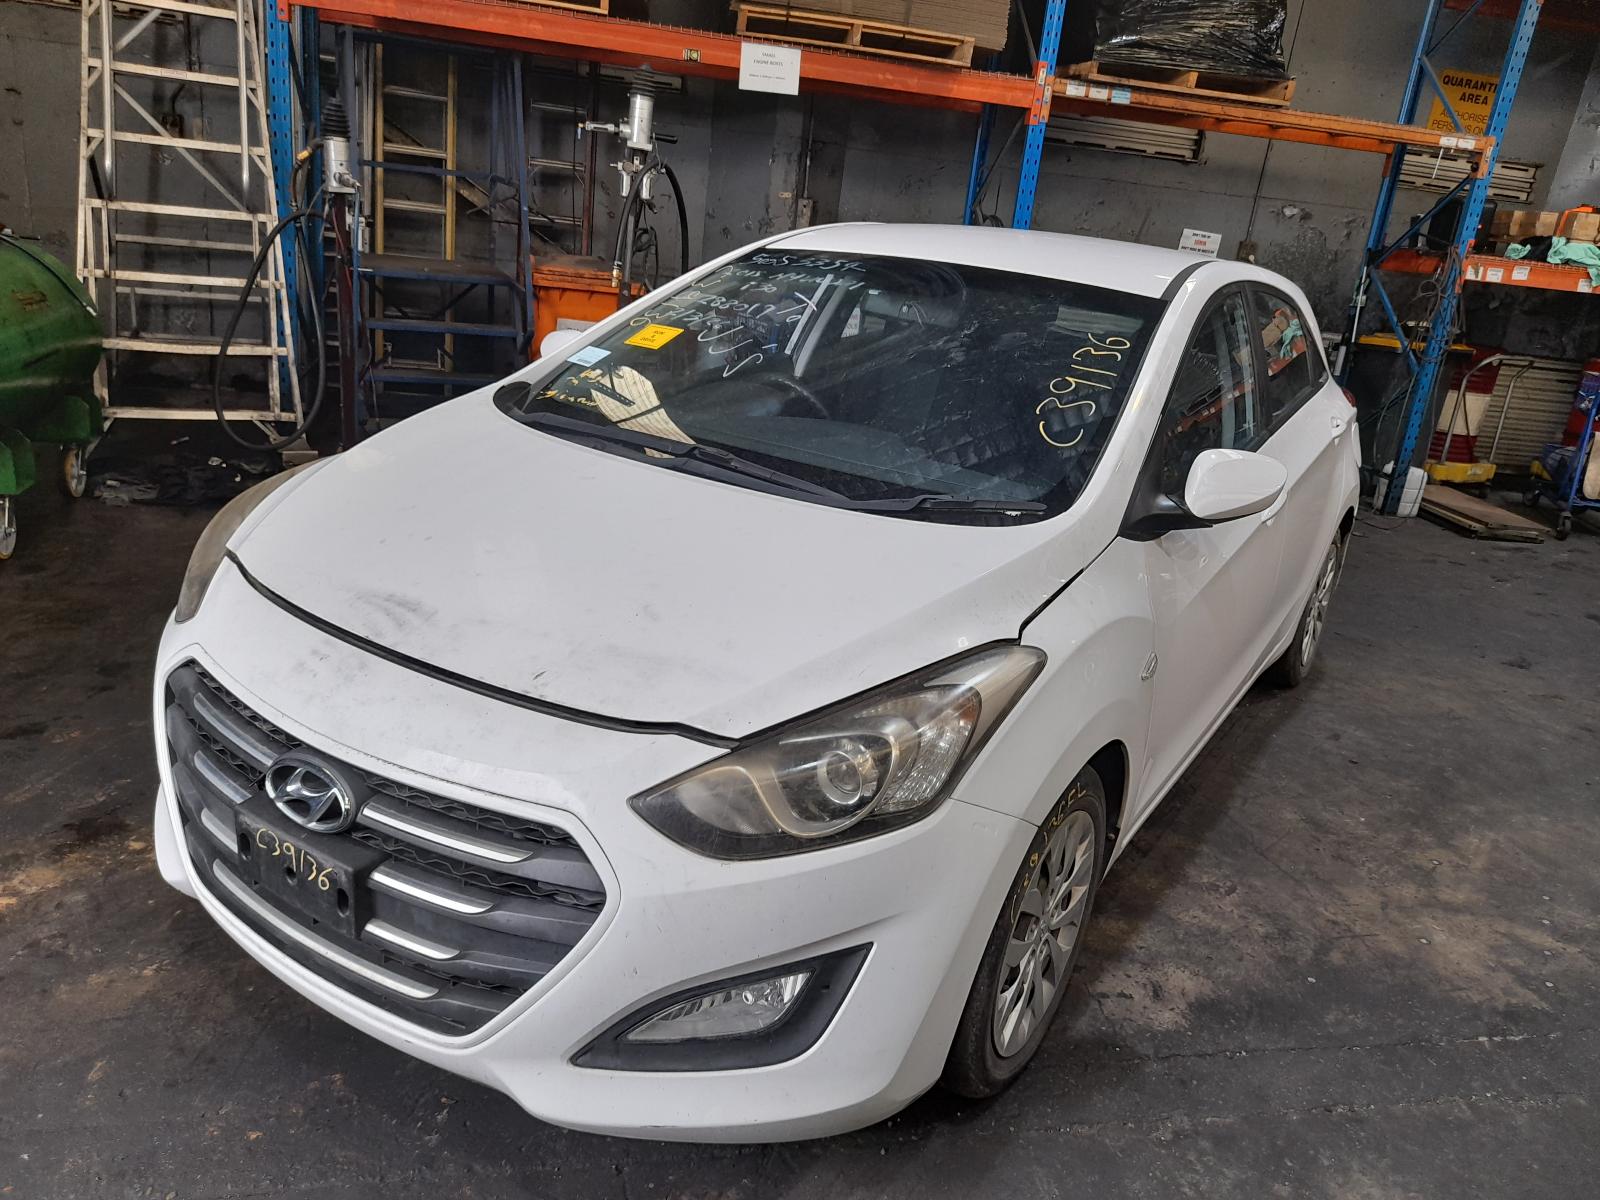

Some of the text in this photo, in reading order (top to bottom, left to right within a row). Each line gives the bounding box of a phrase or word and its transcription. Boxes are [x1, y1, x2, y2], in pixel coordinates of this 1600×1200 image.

[1442, 74, 1498, 93] QUARANTI
[1459, 91, 1489, 106] AREA
[1035, 332, 1131, 448] C39136
[256, 827, 334, 891] C39136
